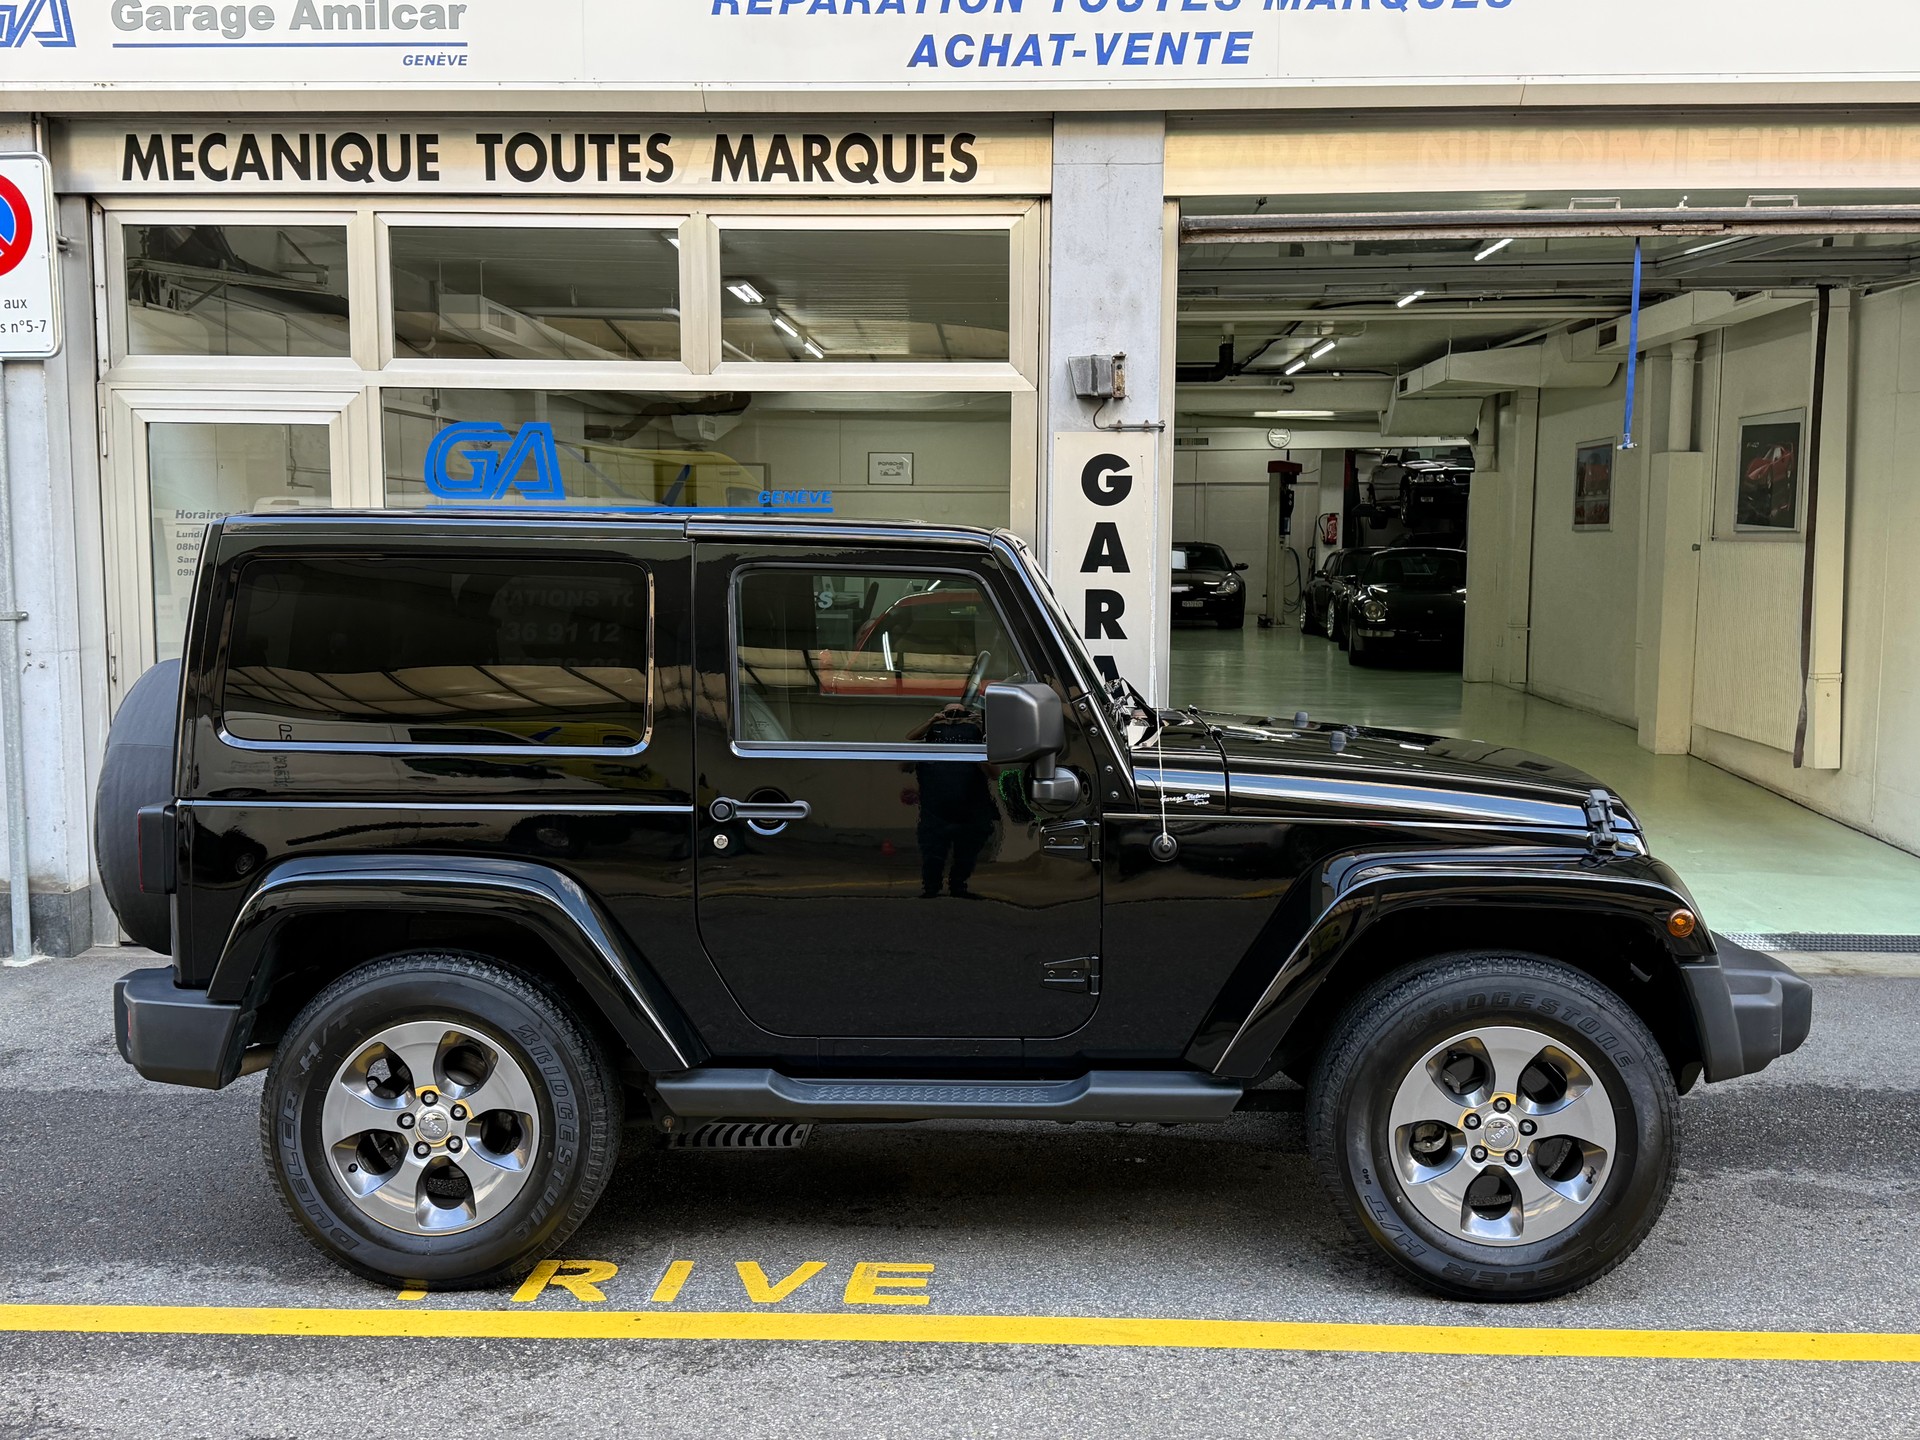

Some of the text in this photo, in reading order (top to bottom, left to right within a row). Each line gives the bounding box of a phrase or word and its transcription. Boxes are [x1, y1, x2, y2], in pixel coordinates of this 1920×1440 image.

[111, 0, 468, 39] Garage Amilcar
[402, 52, 468, 66] GENÈVE
[906, 31, 1254, 67] ACHAT-VENTE
[122, 132, 978, 185] MECANIQUE TOUTES MARQUES
[4, 299, 27, 309] aux
[11, 319, 47, 333] n°5-7
[424, 421, 566, 500] GA
[757, 488, 833, 505] GENÈVE
[176, 543, 200, 551] 08h0
[176, 568, 195, 577] 09h
[1080, 453, 1133, 698] GARA
[1405, 991, 1635, 1069] BRIDGESTONE
[511, 1024, 575, 1241] BRIDGESTONE
[280, 1090, 361, 1250] DUELER
[1364, 1195, 1427, 1258] H/T
[397, 1259, 936, 1305] RIVE
